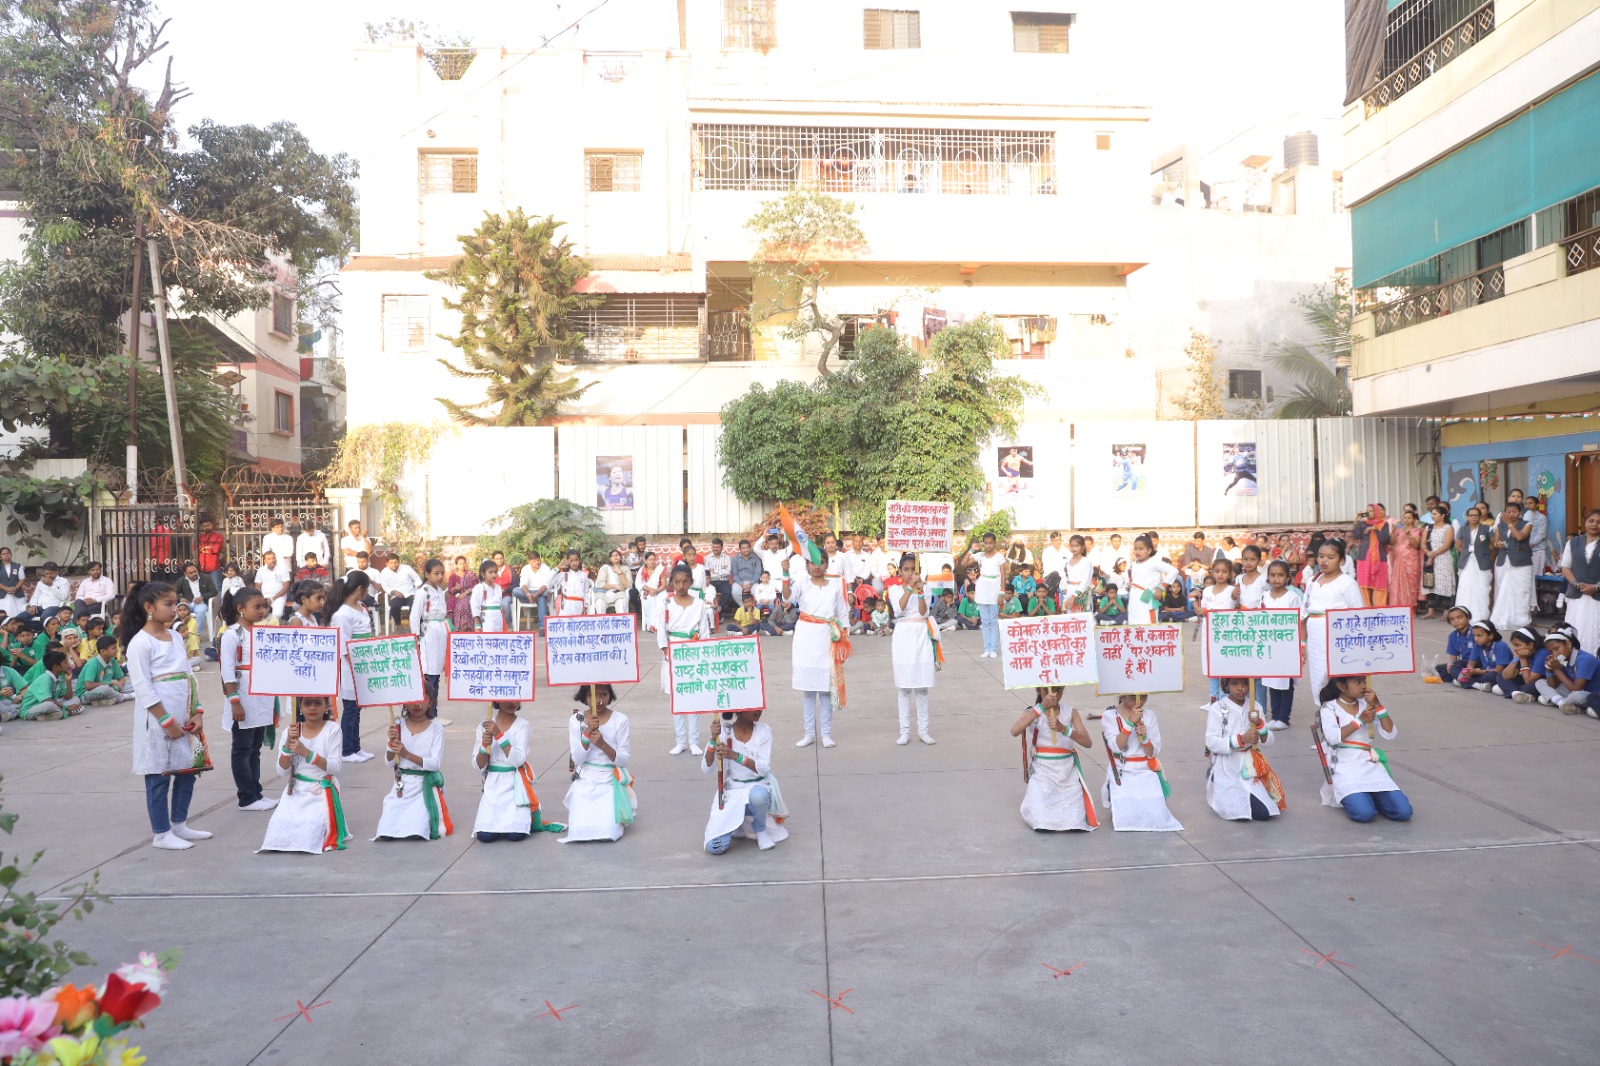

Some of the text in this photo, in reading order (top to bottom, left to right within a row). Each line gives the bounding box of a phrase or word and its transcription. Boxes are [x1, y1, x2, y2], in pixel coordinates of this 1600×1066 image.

[1212, 612, 1230, 628] देश
[1070, 637, 1087, 650] का
[304, 650, 335, 662] पहचान
